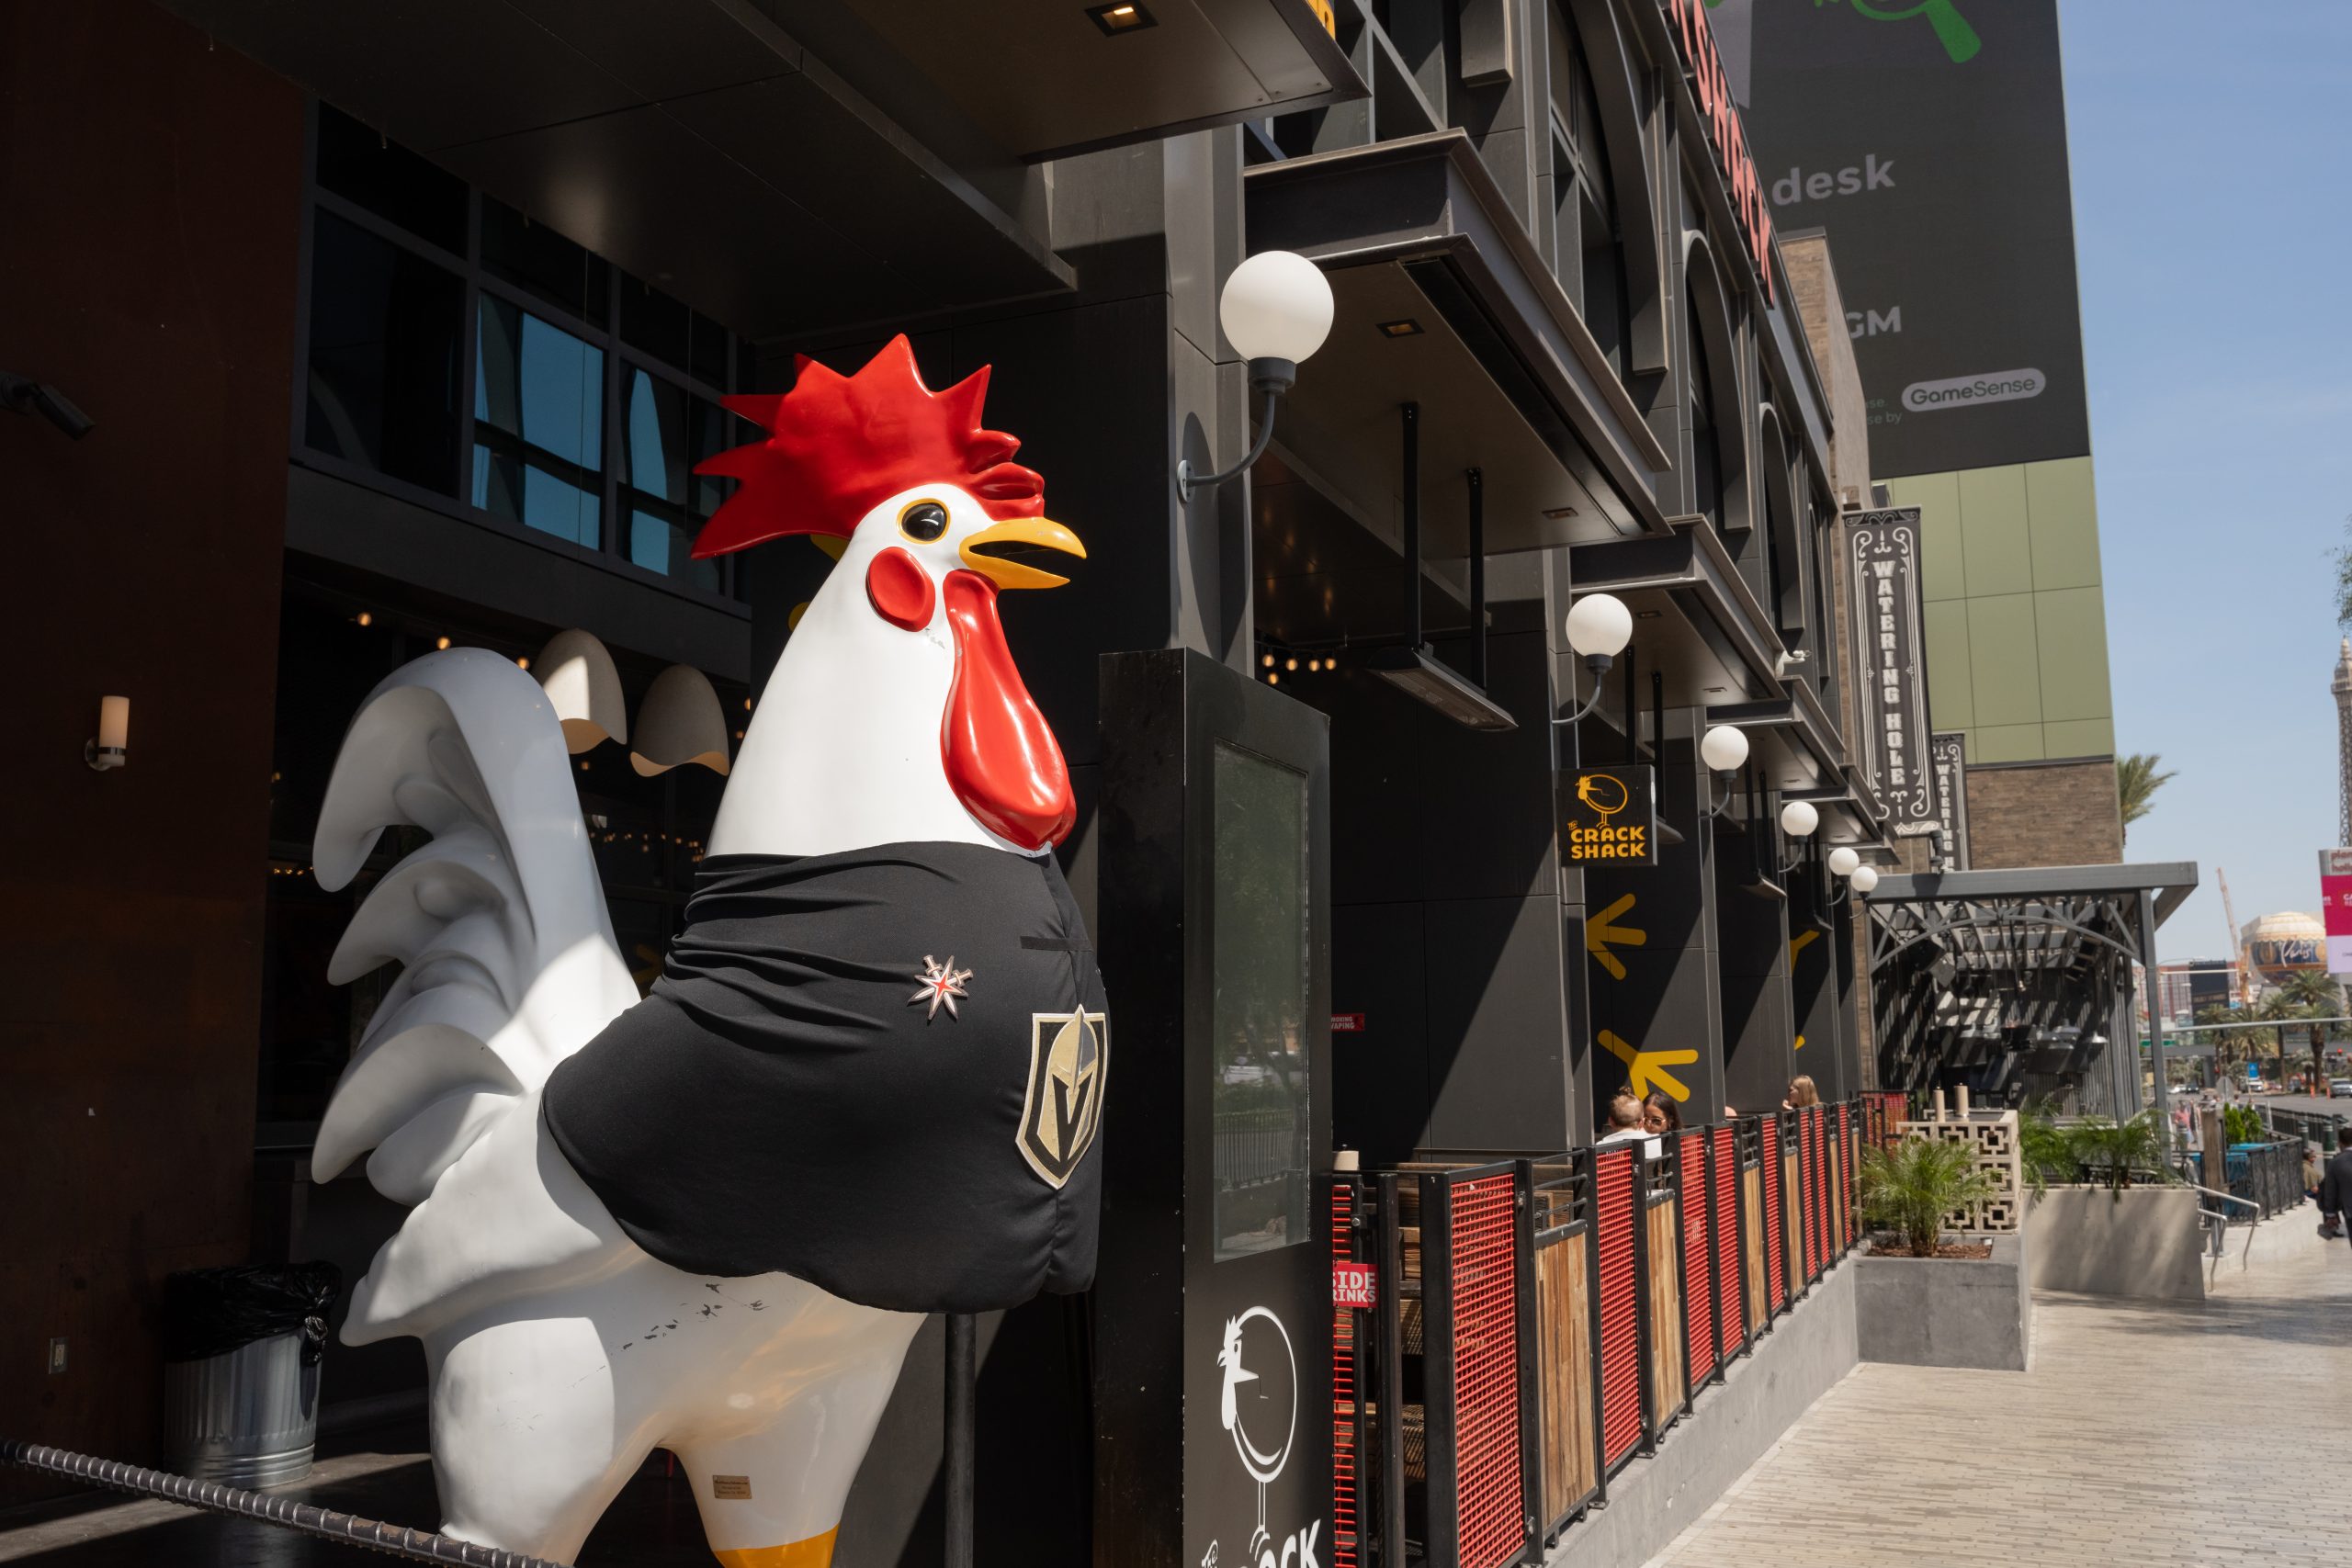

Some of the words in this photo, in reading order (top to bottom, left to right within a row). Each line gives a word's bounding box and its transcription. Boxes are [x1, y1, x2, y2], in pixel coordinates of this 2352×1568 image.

[1771, 153, 1895, 206] desk
[1910, 378, 2036, 405] GameSense
[1885, 411, 1903, 425] by
[1872, 561, 1900, 705] WATERING
[1885, 713, 1905, 784] HOLE
[1936, 764, 1954, 852] WATERING
[1570, 826, 1646, 842] CRACK
[1571, 842, 1646, 859] SHACK
